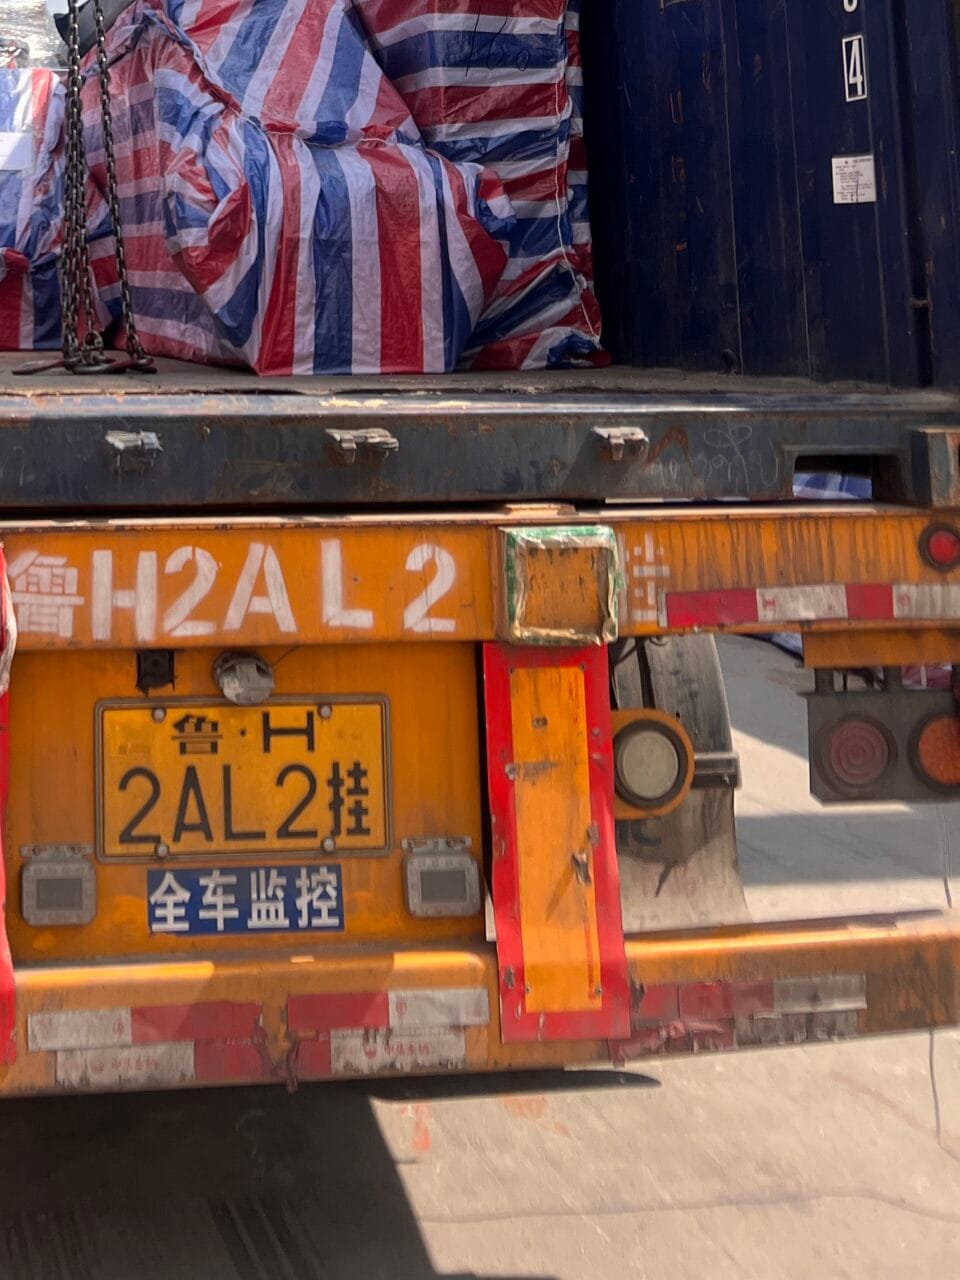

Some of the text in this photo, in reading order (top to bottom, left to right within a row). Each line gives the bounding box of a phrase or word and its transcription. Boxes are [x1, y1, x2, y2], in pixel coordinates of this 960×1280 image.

[846, 37, 865, 99] 4
[118, 761, 371, 844] 2AL2挂
[149, 866, 340, 932] 全车监控
